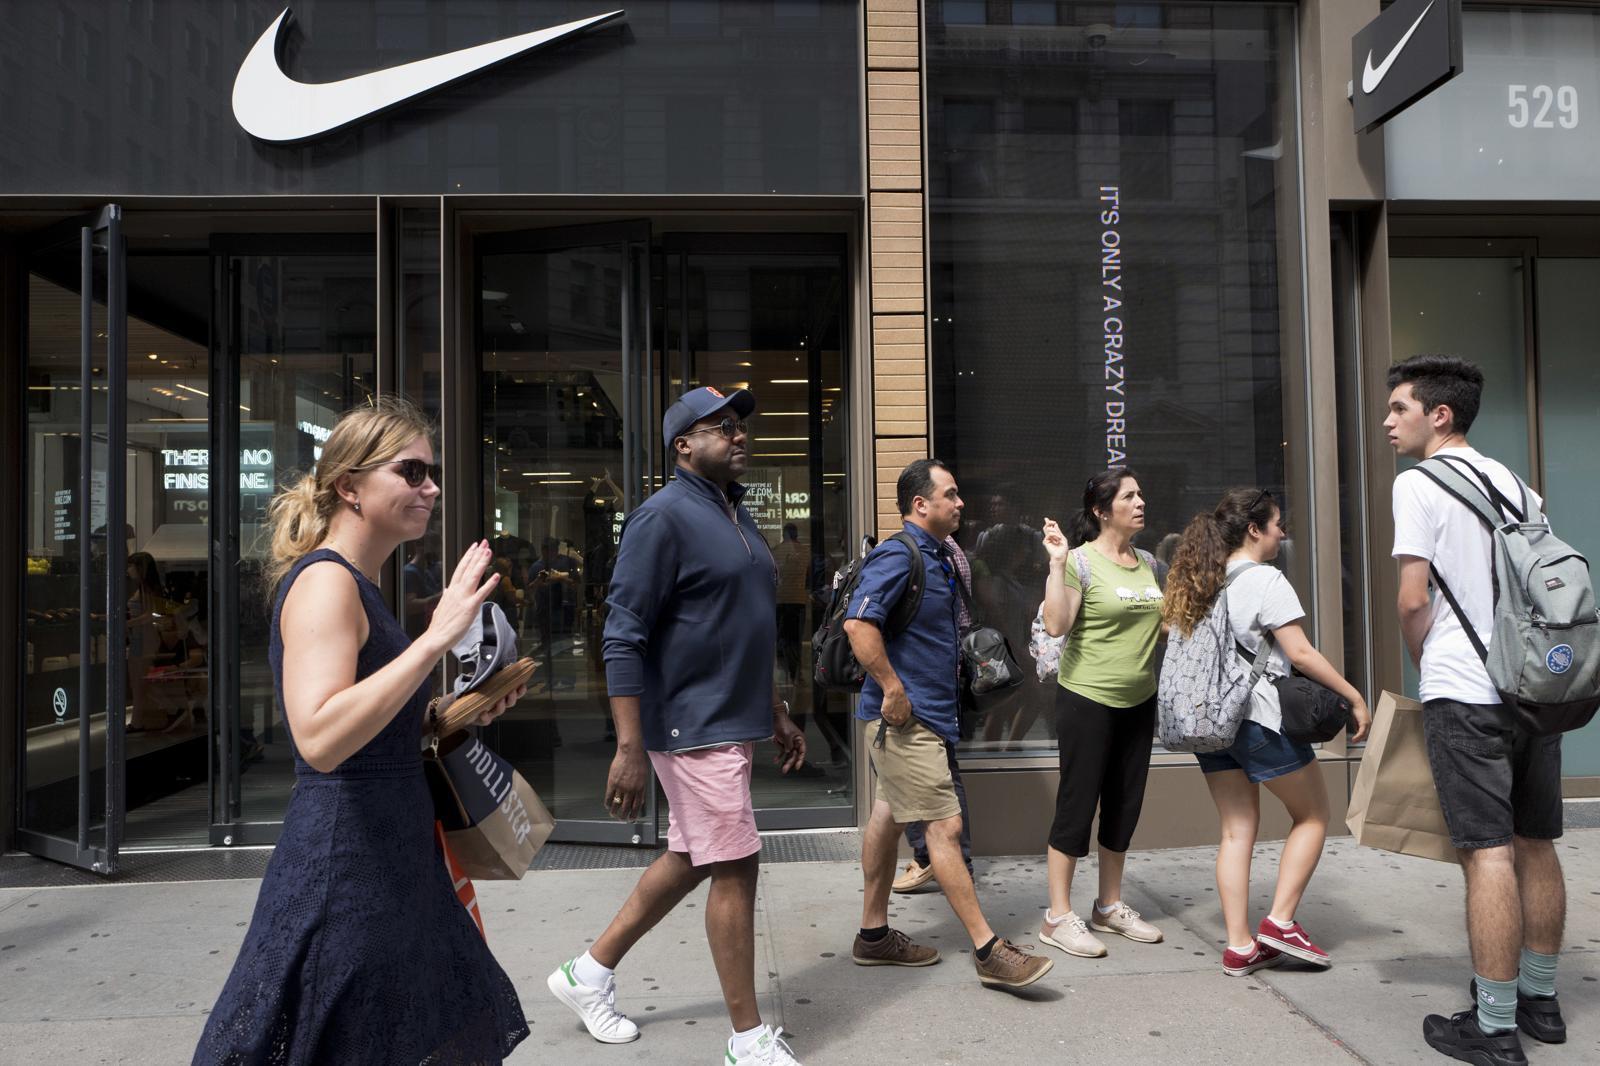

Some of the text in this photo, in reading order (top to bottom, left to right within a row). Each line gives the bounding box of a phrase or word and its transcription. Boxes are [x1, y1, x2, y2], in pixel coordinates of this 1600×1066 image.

[1508, 84, 1579, 129] 529
[1099, 185, 1127, 470] IT'S ONLY A CRAZY DREA
[161, 449, 272, 466] THER NO
[164, 472, 208, 489] FINIS
[746, 487, 773, 497] KE.COM
[466, 738, 531, 844] HOLLISTER
